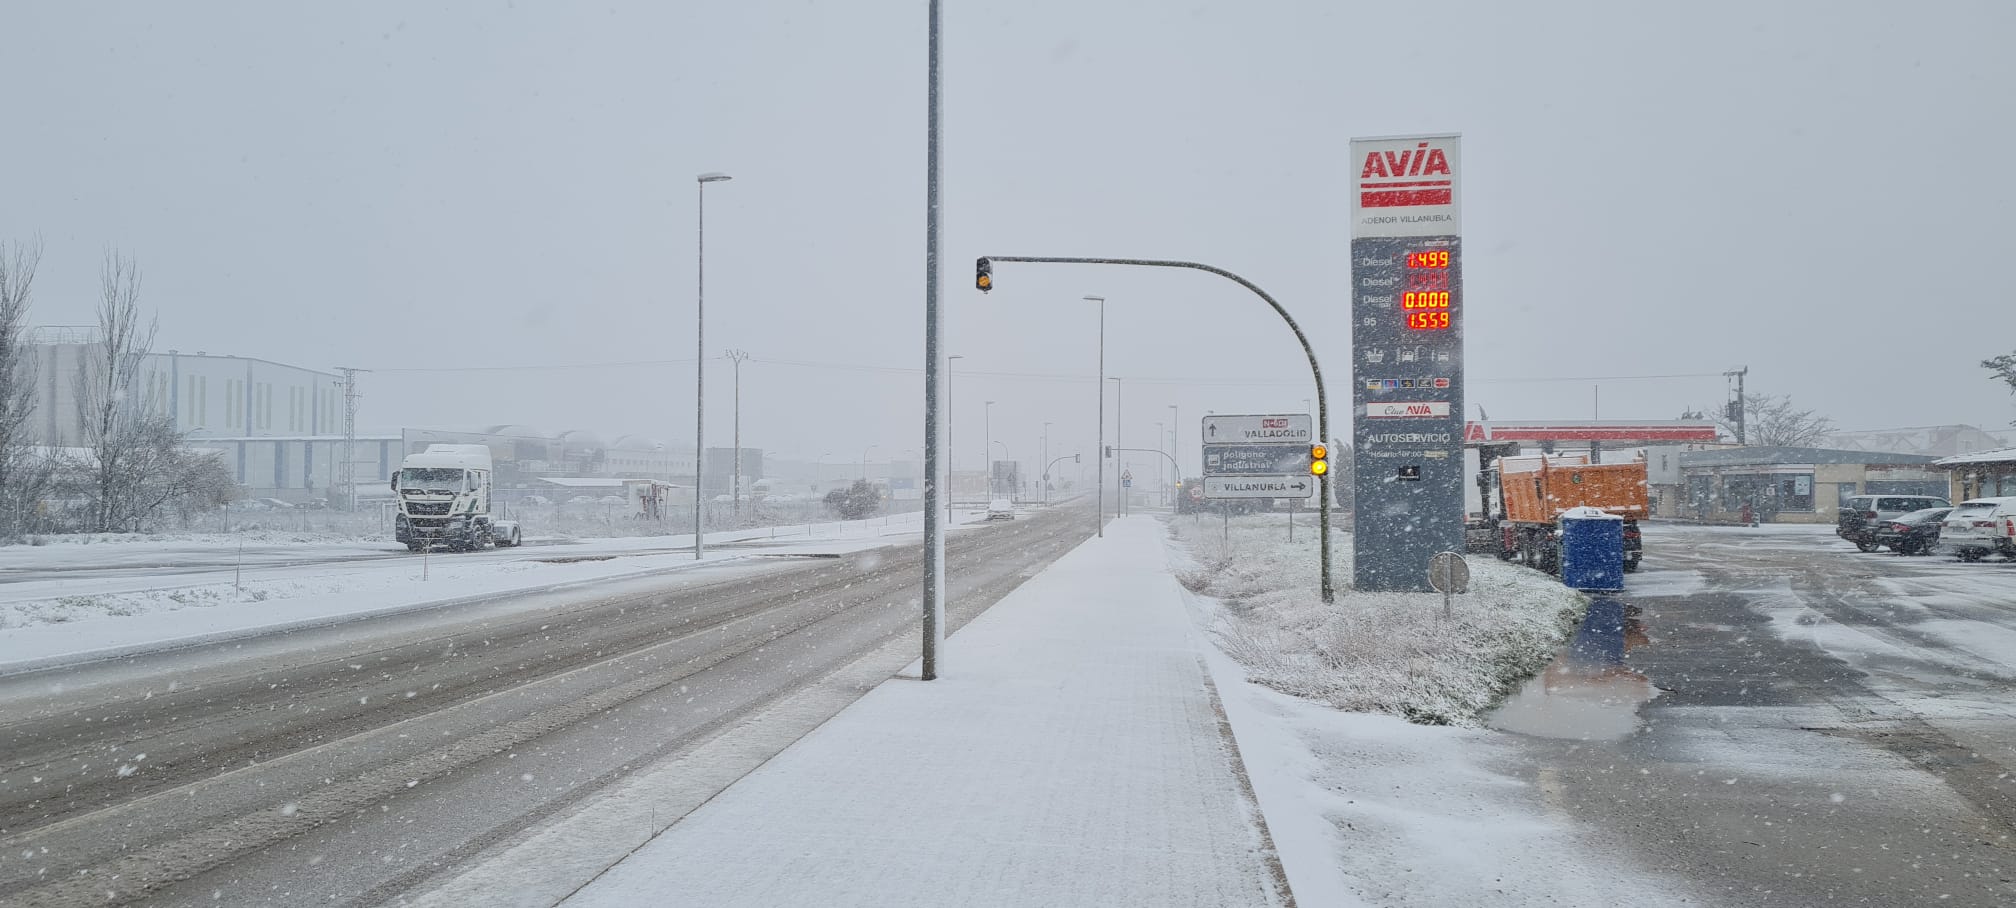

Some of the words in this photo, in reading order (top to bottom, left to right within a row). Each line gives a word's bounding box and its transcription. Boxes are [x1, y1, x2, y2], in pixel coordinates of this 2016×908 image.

[1361, 142, 1451, 178] AVÍA
[1361, 216, 1397, 225] ADENOR
[1400, 214, 1452, 224] VILLANUBLA
[1409, 251, 1448, 268] 1.499
[1405, 292, 1449, 308] 0.000
[1410, 312, 1449, 328] 1.559
[1245, 430, 1307, 438] VALLADOLID
[1368, 433, 1450, 443] AUTOSERVICIO
[1224, 483, 1287, 491] VILLANUBLA
